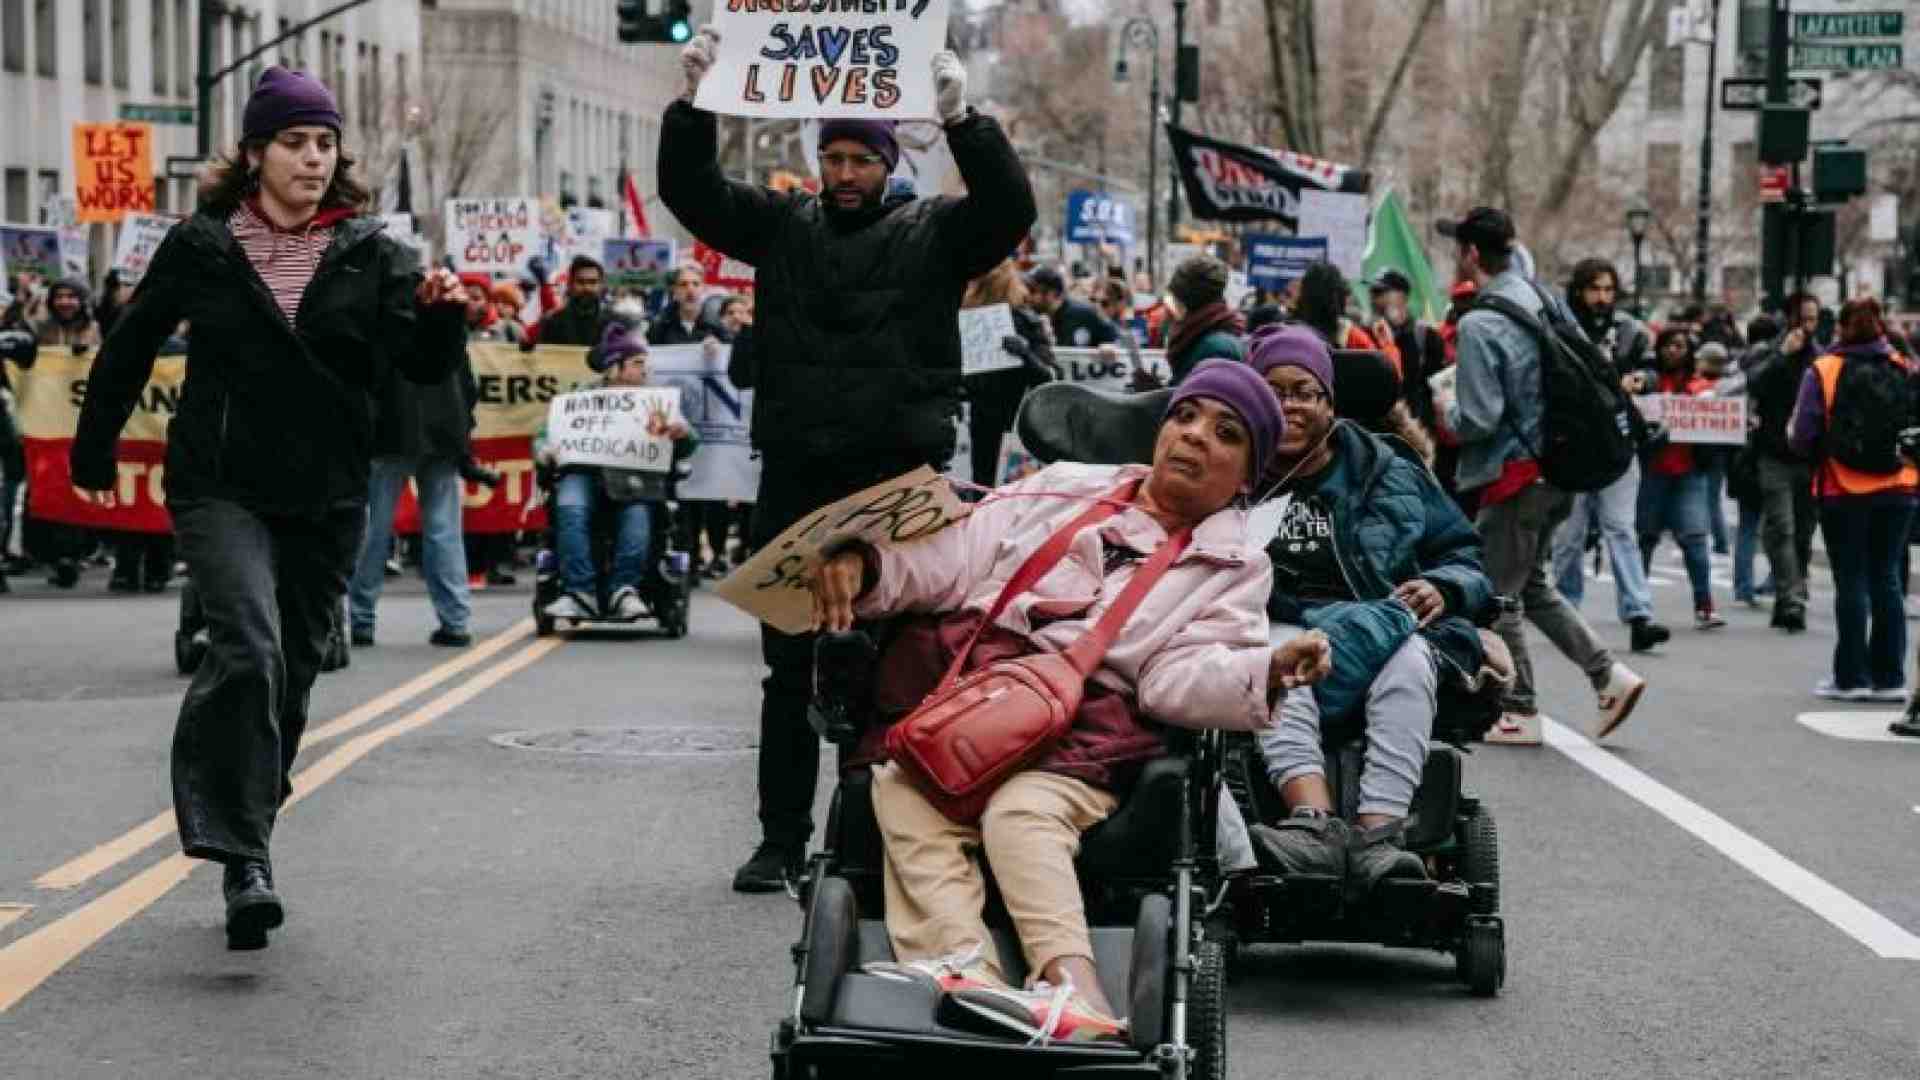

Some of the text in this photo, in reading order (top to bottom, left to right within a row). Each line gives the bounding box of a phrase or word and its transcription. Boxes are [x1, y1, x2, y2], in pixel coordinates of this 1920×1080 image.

[760, 22, 899, 67] SAVES
[743, 63, 901, 109] LIVES
[85, 128, 144, 157] LET
[95, 159, 134, 184] US
[77, 185, 153, 211] WORK
[464, 243, 524, 263] COUP
[478, 374, 560, 404] ERS
[564, 391, 635, 415] HANDS
[570, 415, 613, 432] OFF
[561, 437, 660, 463] MEDICAID
